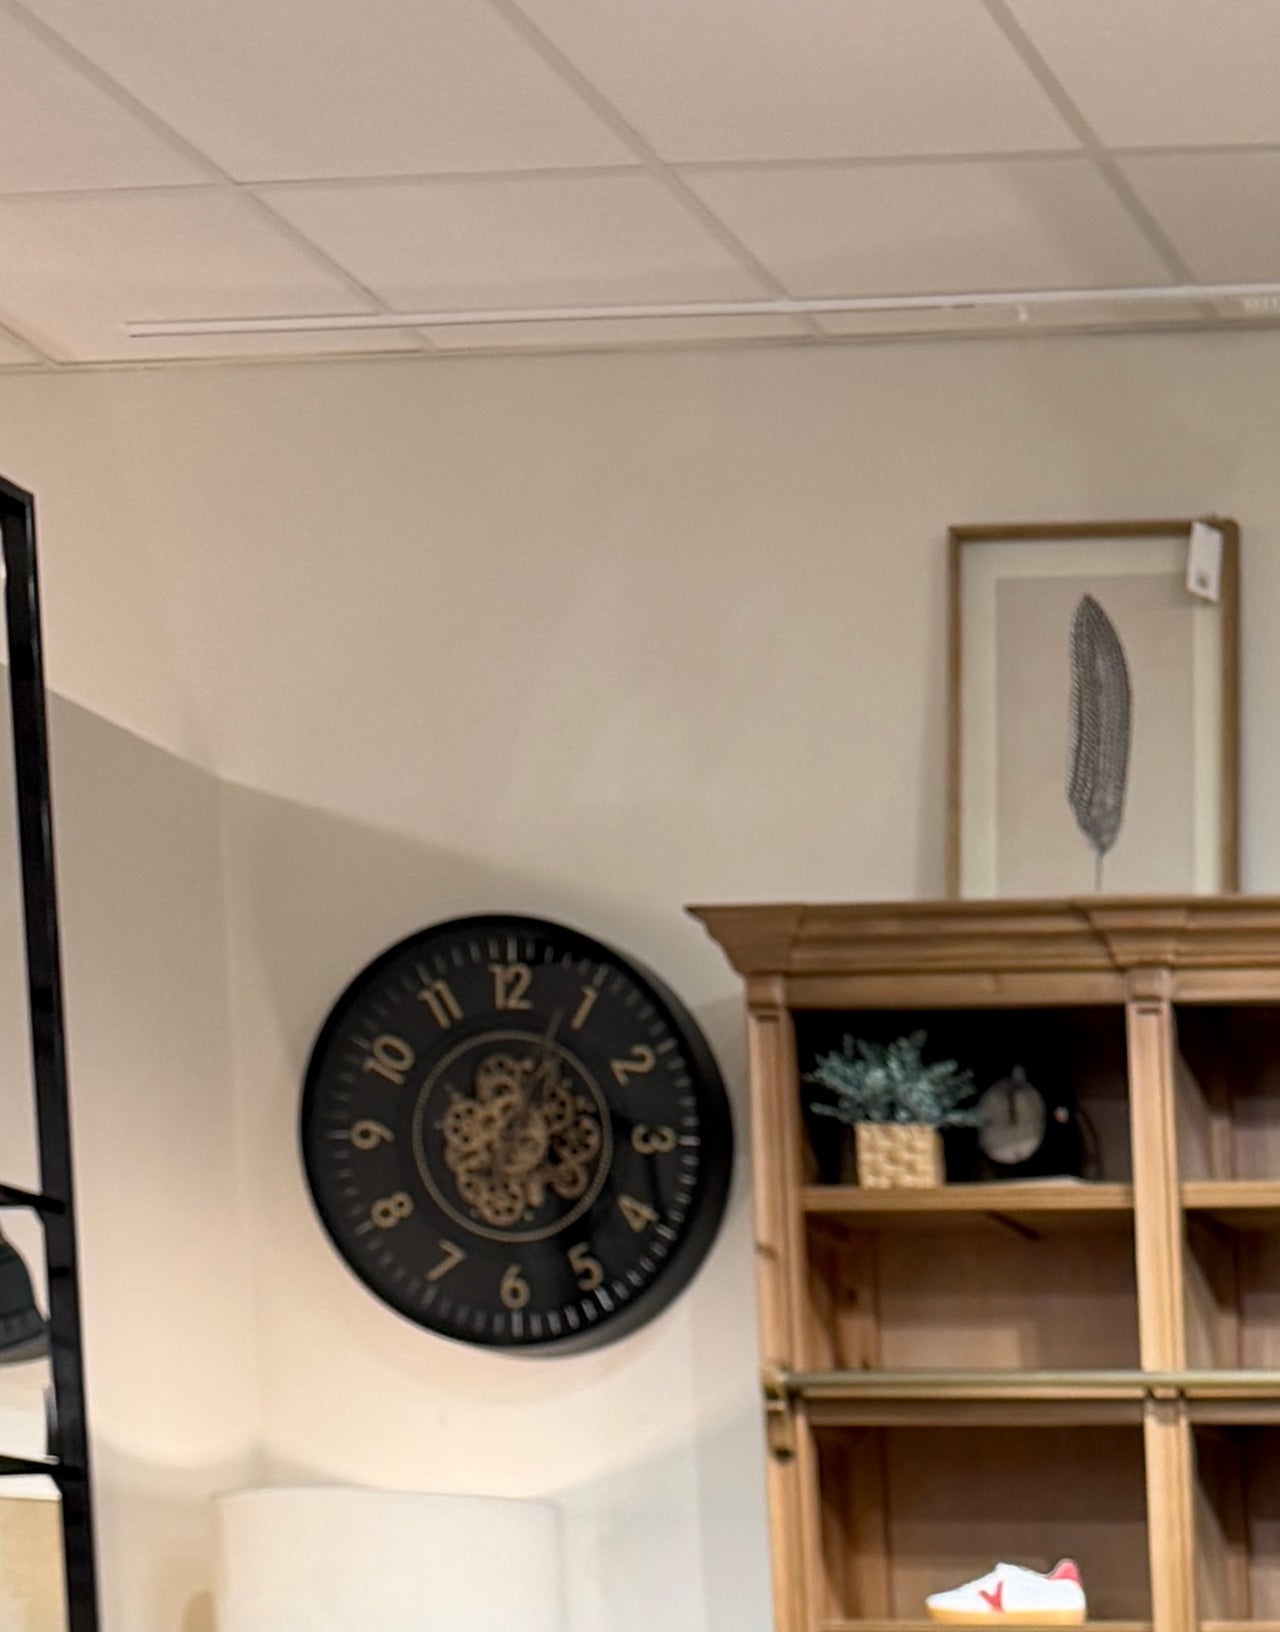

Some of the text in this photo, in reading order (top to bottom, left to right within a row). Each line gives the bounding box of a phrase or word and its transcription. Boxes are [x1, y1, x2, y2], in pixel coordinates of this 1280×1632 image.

[420, 981, 462, 1028] 11
[490, 964, 531, 1008] 12
[572, 987, 595, 1029] 1
[364, 1036, 413, 1083] 10
[611, 1046, 655, 1085] 2
[351, 1121, 393, 1148] 9
[633, 1126, 674, 1153] 3
[372, 1193, 413, 1227] 8
[619, 1196, 657, 1231] 4
[427, 1241, 465, 1279] 7
[568, 1243, 600, 1289] 5
[503, 1266, 529, 1307] 6
